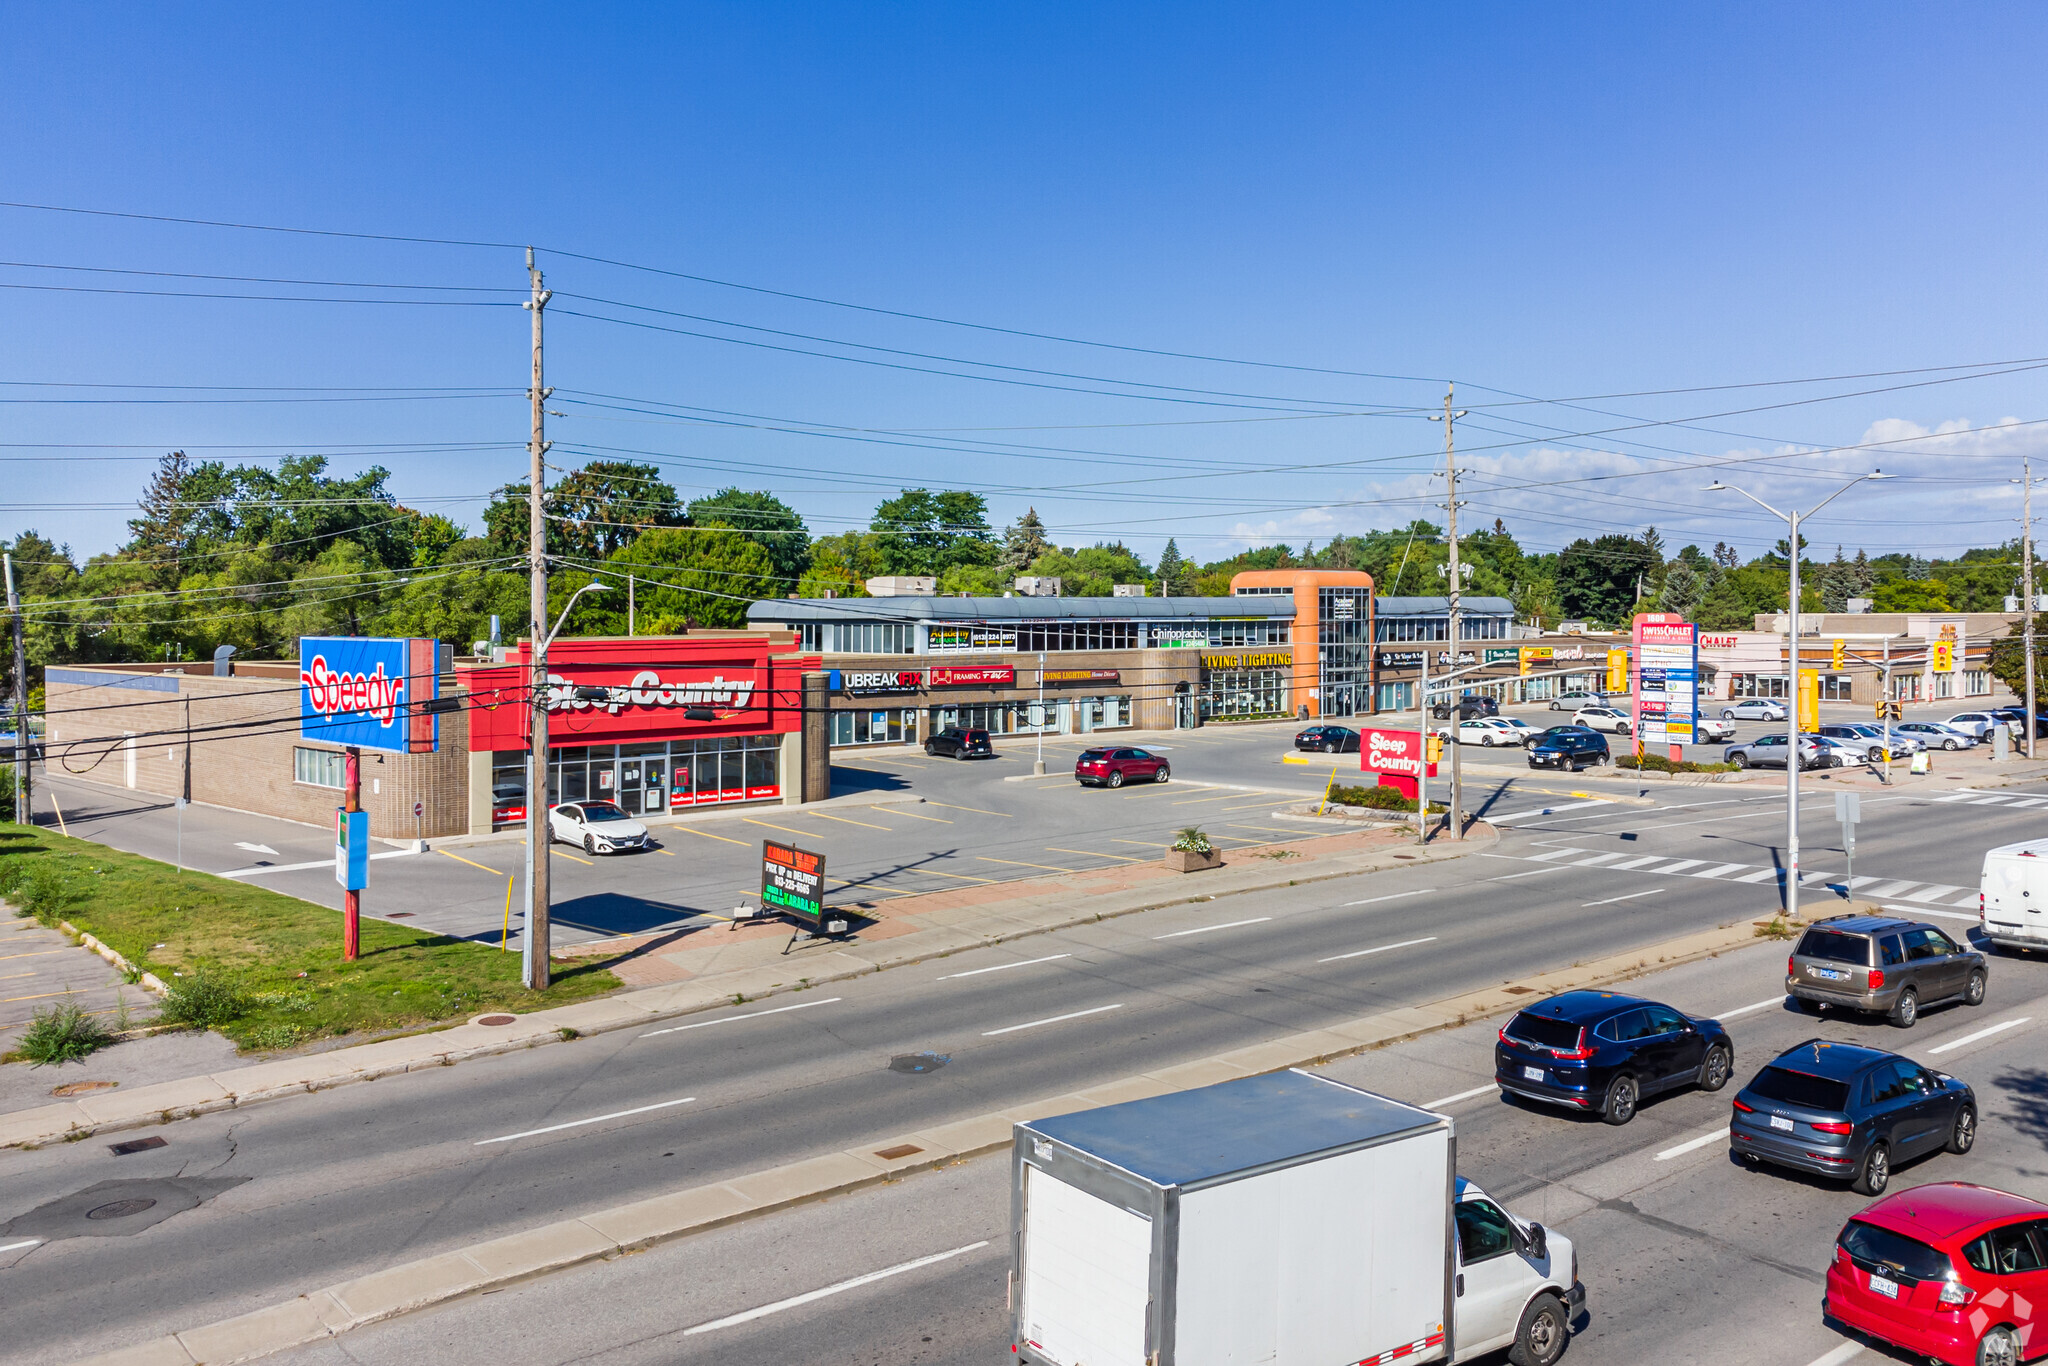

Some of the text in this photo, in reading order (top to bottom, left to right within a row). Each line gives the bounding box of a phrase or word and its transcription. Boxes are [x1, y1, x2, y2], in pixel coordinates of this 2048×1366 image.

[1647, 614, 1665, 622] 1600
[1151, 628, 1205, 640] Chiropractic
[1700, 634, 1738, 649] CHALET
[1201, 653, 1292, 669] LIVING LIGHTING
[953, 673, 981, 681] FRAMING
[1062, 671, 1091, 679] LIGHTING
[302, 655, 403, 727] Speedy
[1369, 732, 1407, 755] Sleep
[1369, 750, 1421, 774] Country
[765, 861, 777, 874] PICK
[778, 865, 786, 877] UP
[793, 870, 818, 886] DELIVERY
